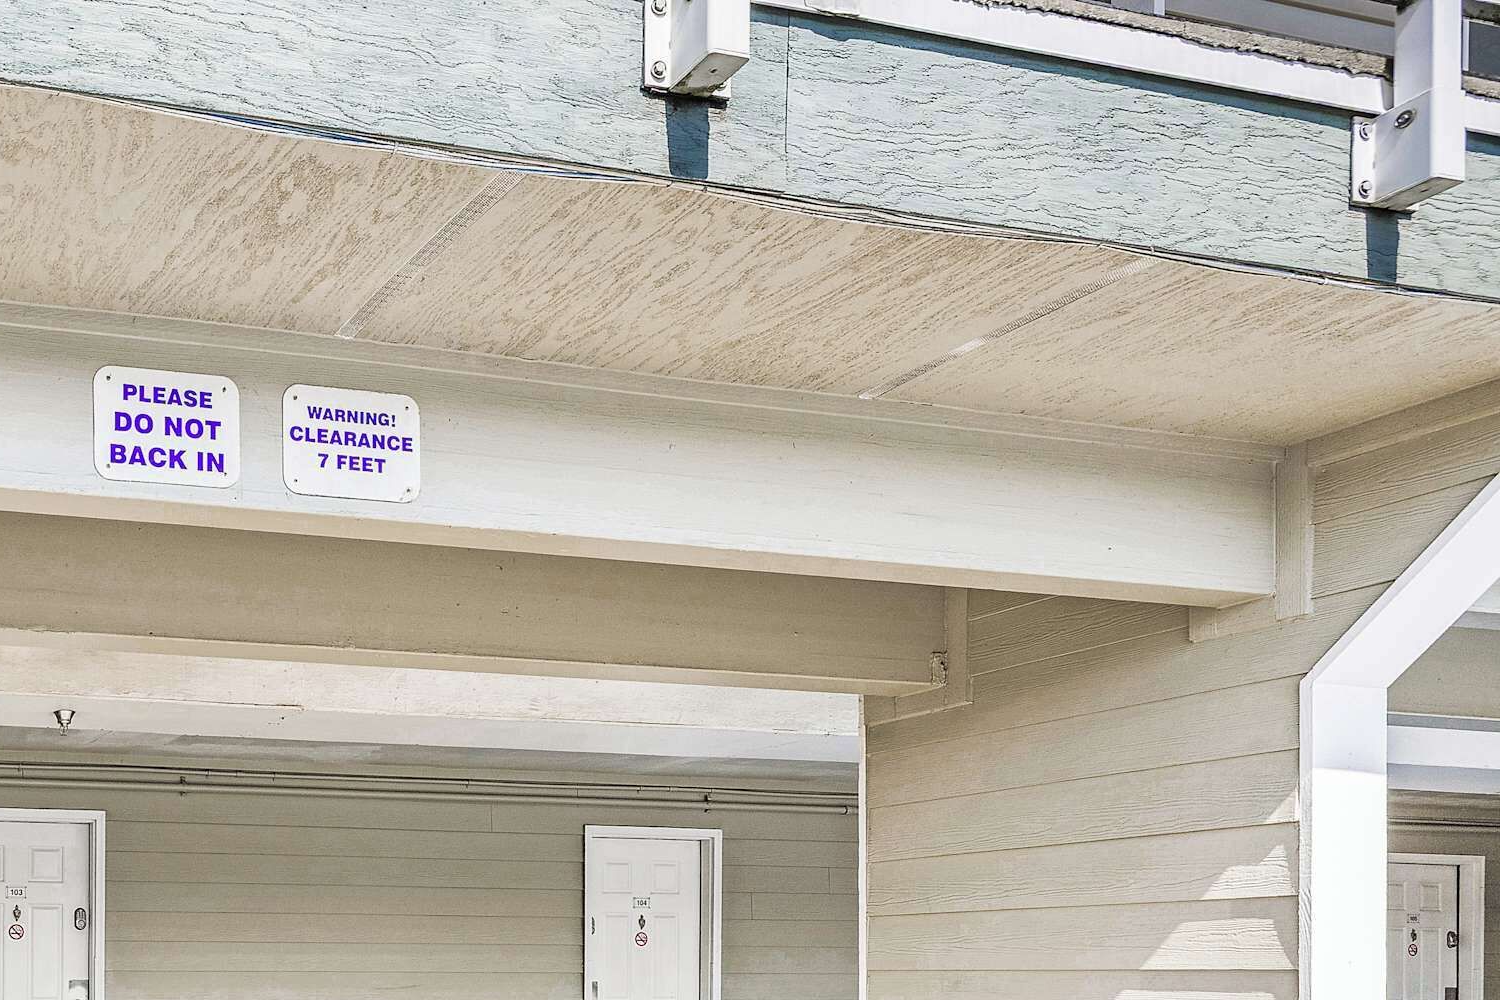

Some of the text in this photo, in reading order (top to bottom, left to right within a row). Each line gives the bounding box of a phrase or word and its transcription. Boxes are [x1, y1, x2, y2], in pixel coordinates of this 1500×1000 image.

[122, 383, 213, 409] PLEASE
[114, 410, 222, 441] DO NOT
[307, 405, 396, 427] WARNING!
[289, 426, 413, 452] CLEARANCE
[109, 443, 225, 473] BACK IN
[319, 452, 386, 474] 7 FEET
